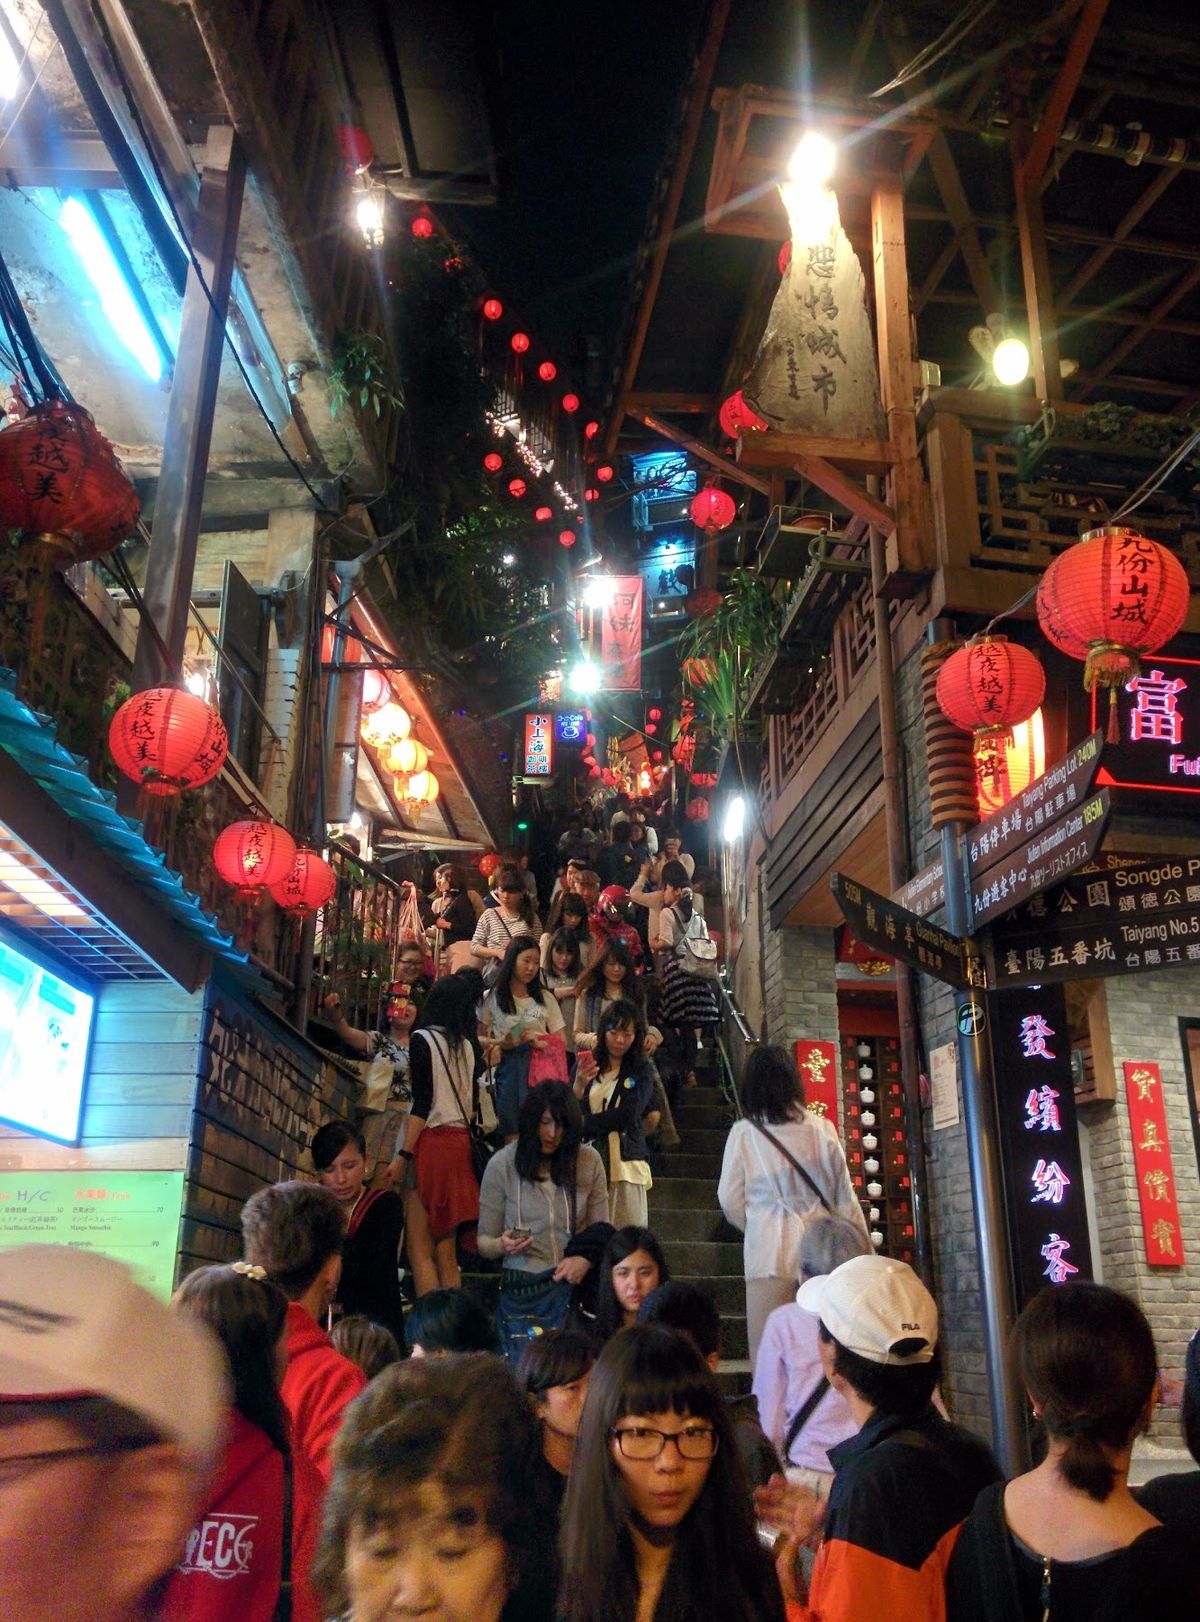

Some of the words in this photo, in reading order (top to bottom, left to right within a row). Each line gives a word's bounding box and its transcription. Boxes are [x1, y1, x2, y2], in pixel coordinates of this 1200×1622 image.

[795, 246, 848, 416] 悲情城市
[1110, 537, 1154, 625] 九份山城
[975, 645, 1003, 713] 越夜越美
[131, 690, 163, 762] 越夜越美
[1125, 669, 1187, 745] 富
[529, 715, 548, 753] 小上海
[1021, 784, 1045, 809] Taiyang
[1044, 765, 1067, 793] Parking
[1067, 754, 1078, 776] Lot
[1077, 738, 1097, 767] 240M
[1083, 797, 1104, 826] 185M
[970, 808, 1022, 862] 台陽停車場
[974, 868, 1028, 914] 九份遊客中心
[1115, 863, 1183, 888] Songde
[1007, 881, 1111, 921] 德公園
[1121, 923, 1168, 944] Taiyang
[1169, 916, 1199, 936] No.5
[1004, 937, 1116, 975] 臺陽五番坑
[1018, 985, 1080, 1284] 發繽紛客
[17, 1189, 52, 1203] H/C
[901, 1323, 920, 1331] FILA
